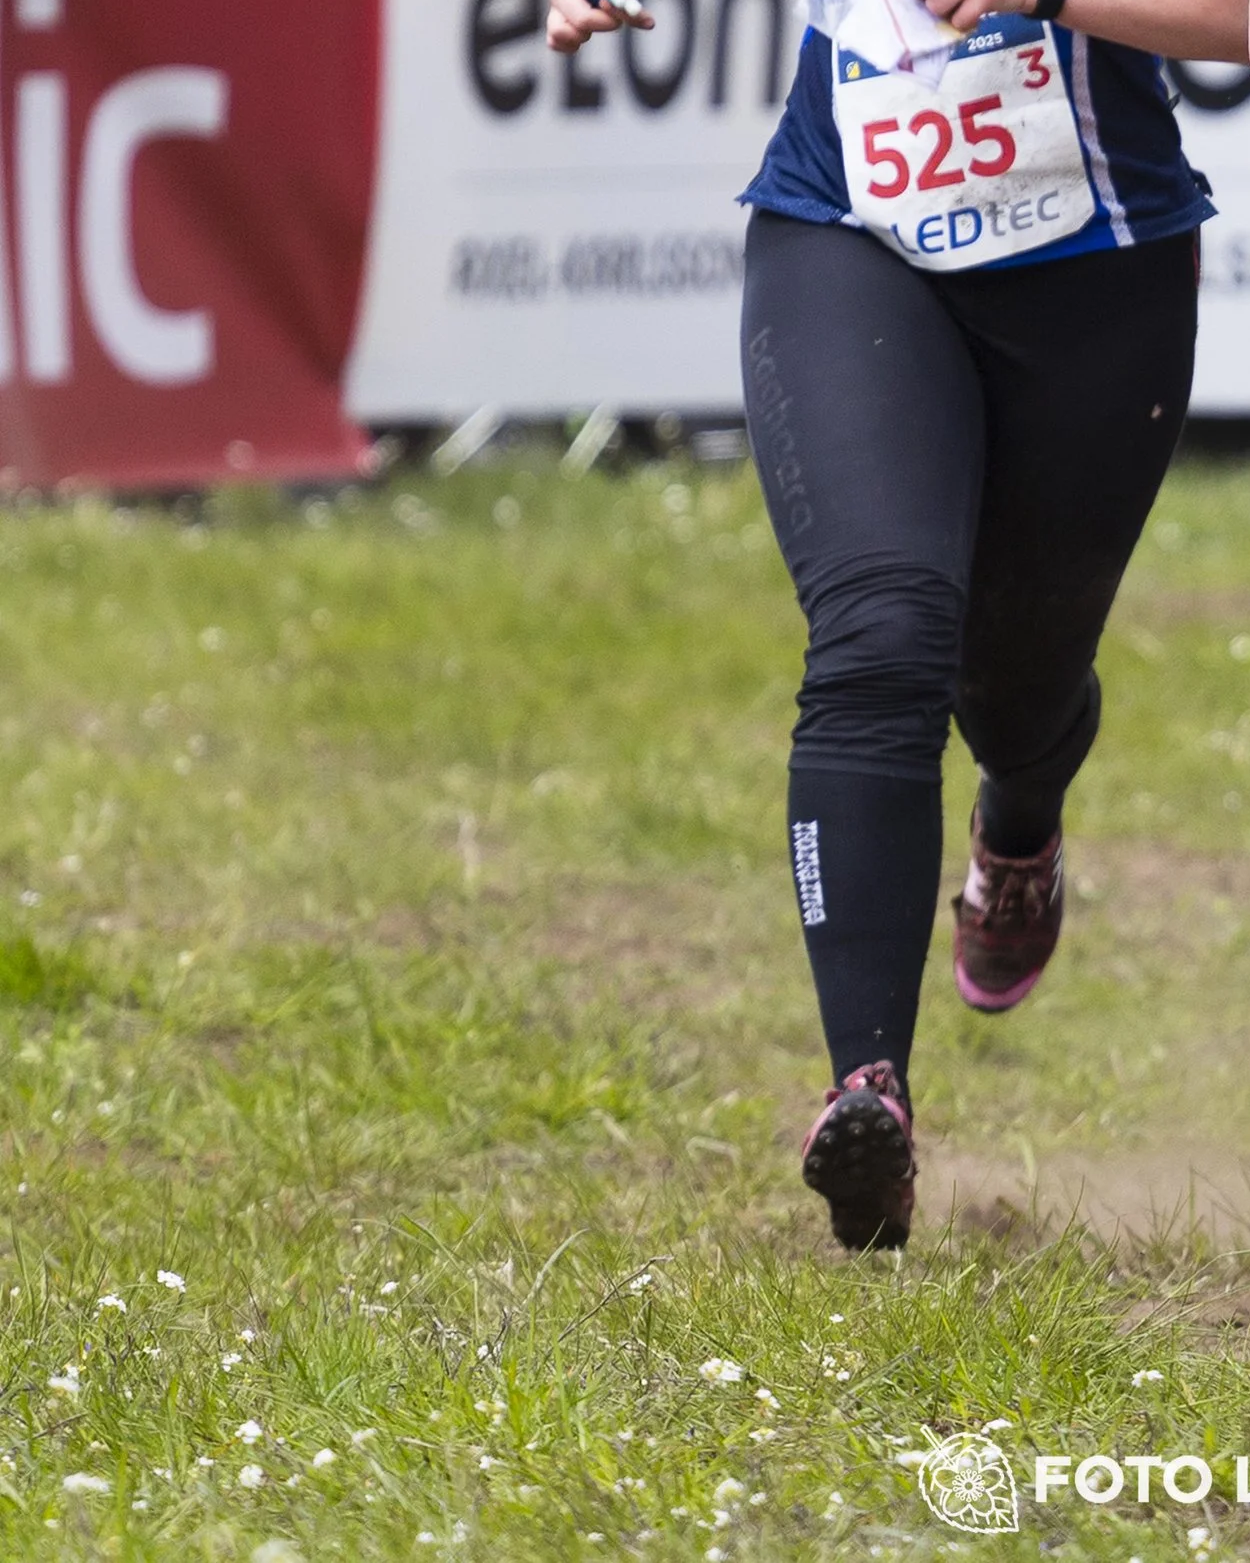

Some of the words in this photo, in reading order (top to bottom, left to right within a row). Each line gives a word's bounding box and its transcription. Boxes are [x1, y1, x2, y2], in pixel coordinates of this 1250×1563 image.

[967, 32, 1004, 52] 2025
[1017, 46, 1051, 89] 3
[862, 93, 1016, 199] 525
